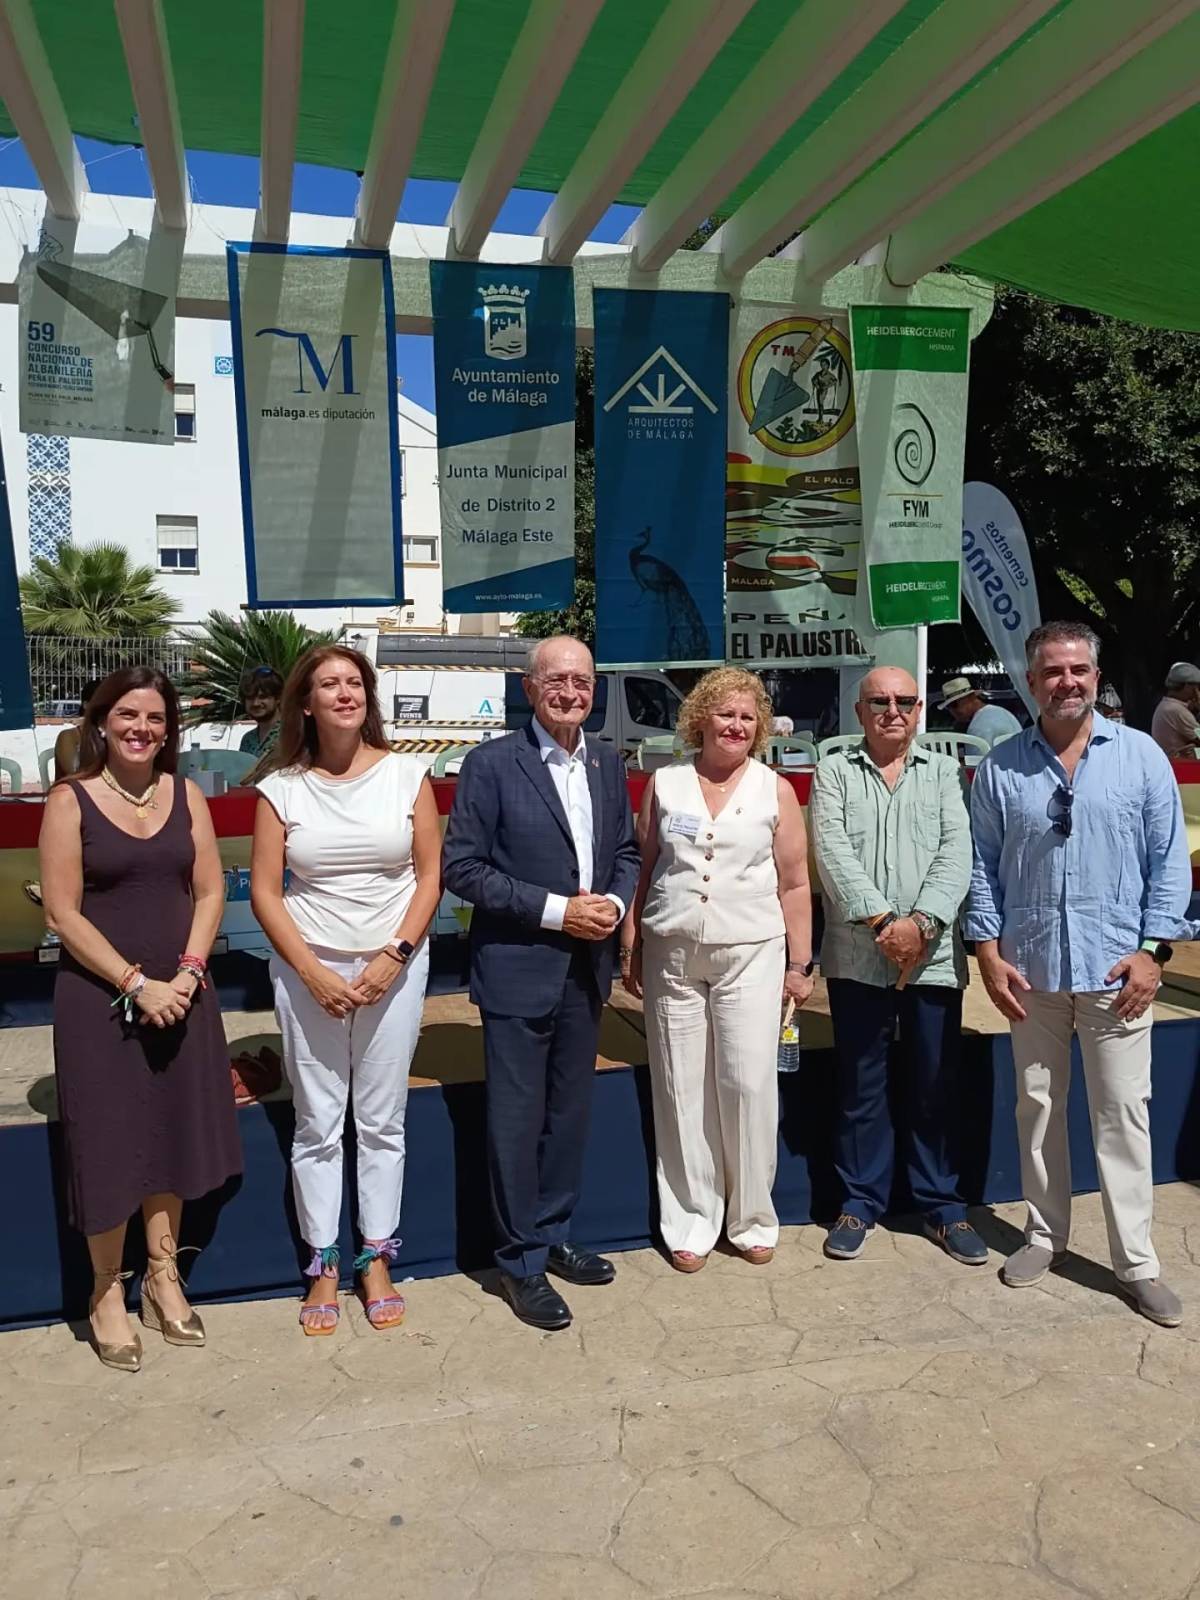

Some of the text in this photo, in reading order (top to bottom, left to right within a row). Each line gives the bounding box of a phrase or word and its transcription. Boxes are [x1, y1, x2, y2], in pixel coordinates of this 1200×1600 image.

[28, 320, 55, 342] 59
[866, 325, 957, 339] HEIDELBERGCEMENT
[28, 342, 81, 356] CONCURSO
[28, 353, 94, 368] NACIONAL DE
[452, 367, 560, 386] Ayuntamiento
[468, 388, 548, 407] de Málaga
[261, 406, 375, 421] málaga.es diputación
[627, 417, 694, 428] ARQUITECTOS
[627, 430, 641, 439] DE
[446, 464, 568, 482] Junta Municipal
[804, 475, 855, 485] EL PALO
[461, 497, 556, 512] de Distrito 2
[903, 499, 930, 518] FYM
[462, 528, 554, 546] Málaga Este
[731, 629, 867, 660] EL PALUSTR
